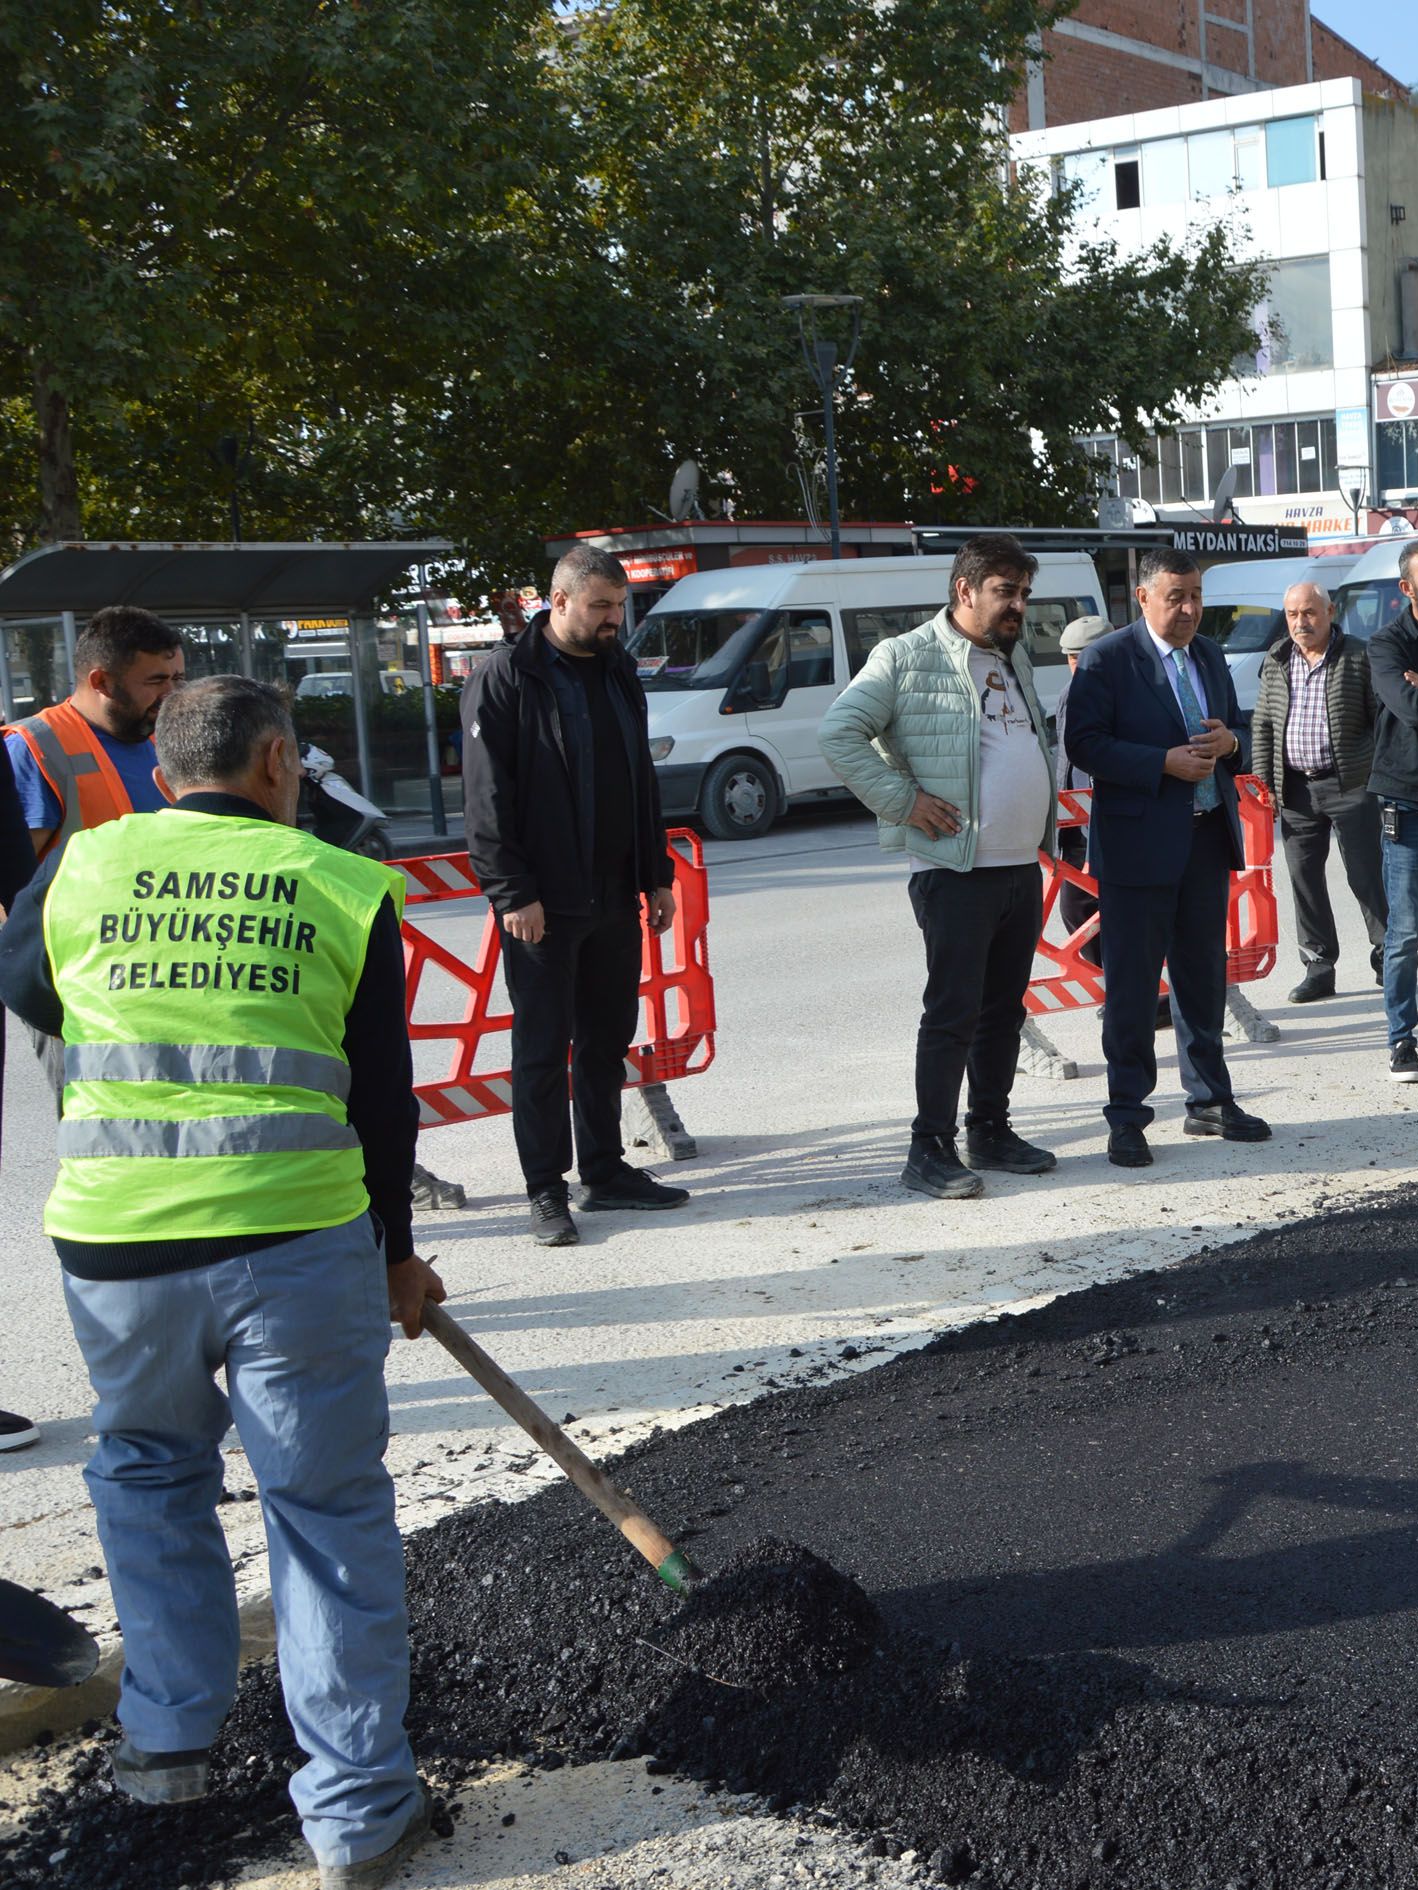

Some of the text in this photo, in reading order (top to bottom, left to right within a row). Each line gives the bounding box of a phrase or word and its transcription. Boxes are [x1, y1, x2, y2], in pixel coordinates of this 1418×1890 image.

[1285, 506, 1324, 518] HAVZA
[1173, 532, 1236, 551] MEYDAN
[1239, 528, 1280, 553] TAKSİ
[132, 870, 299, 906] SAMSUN
[100, 906, 317, 954] BÜYÜKŞEHİR
[108, 955, 302, 995] BELEDİYESİ
